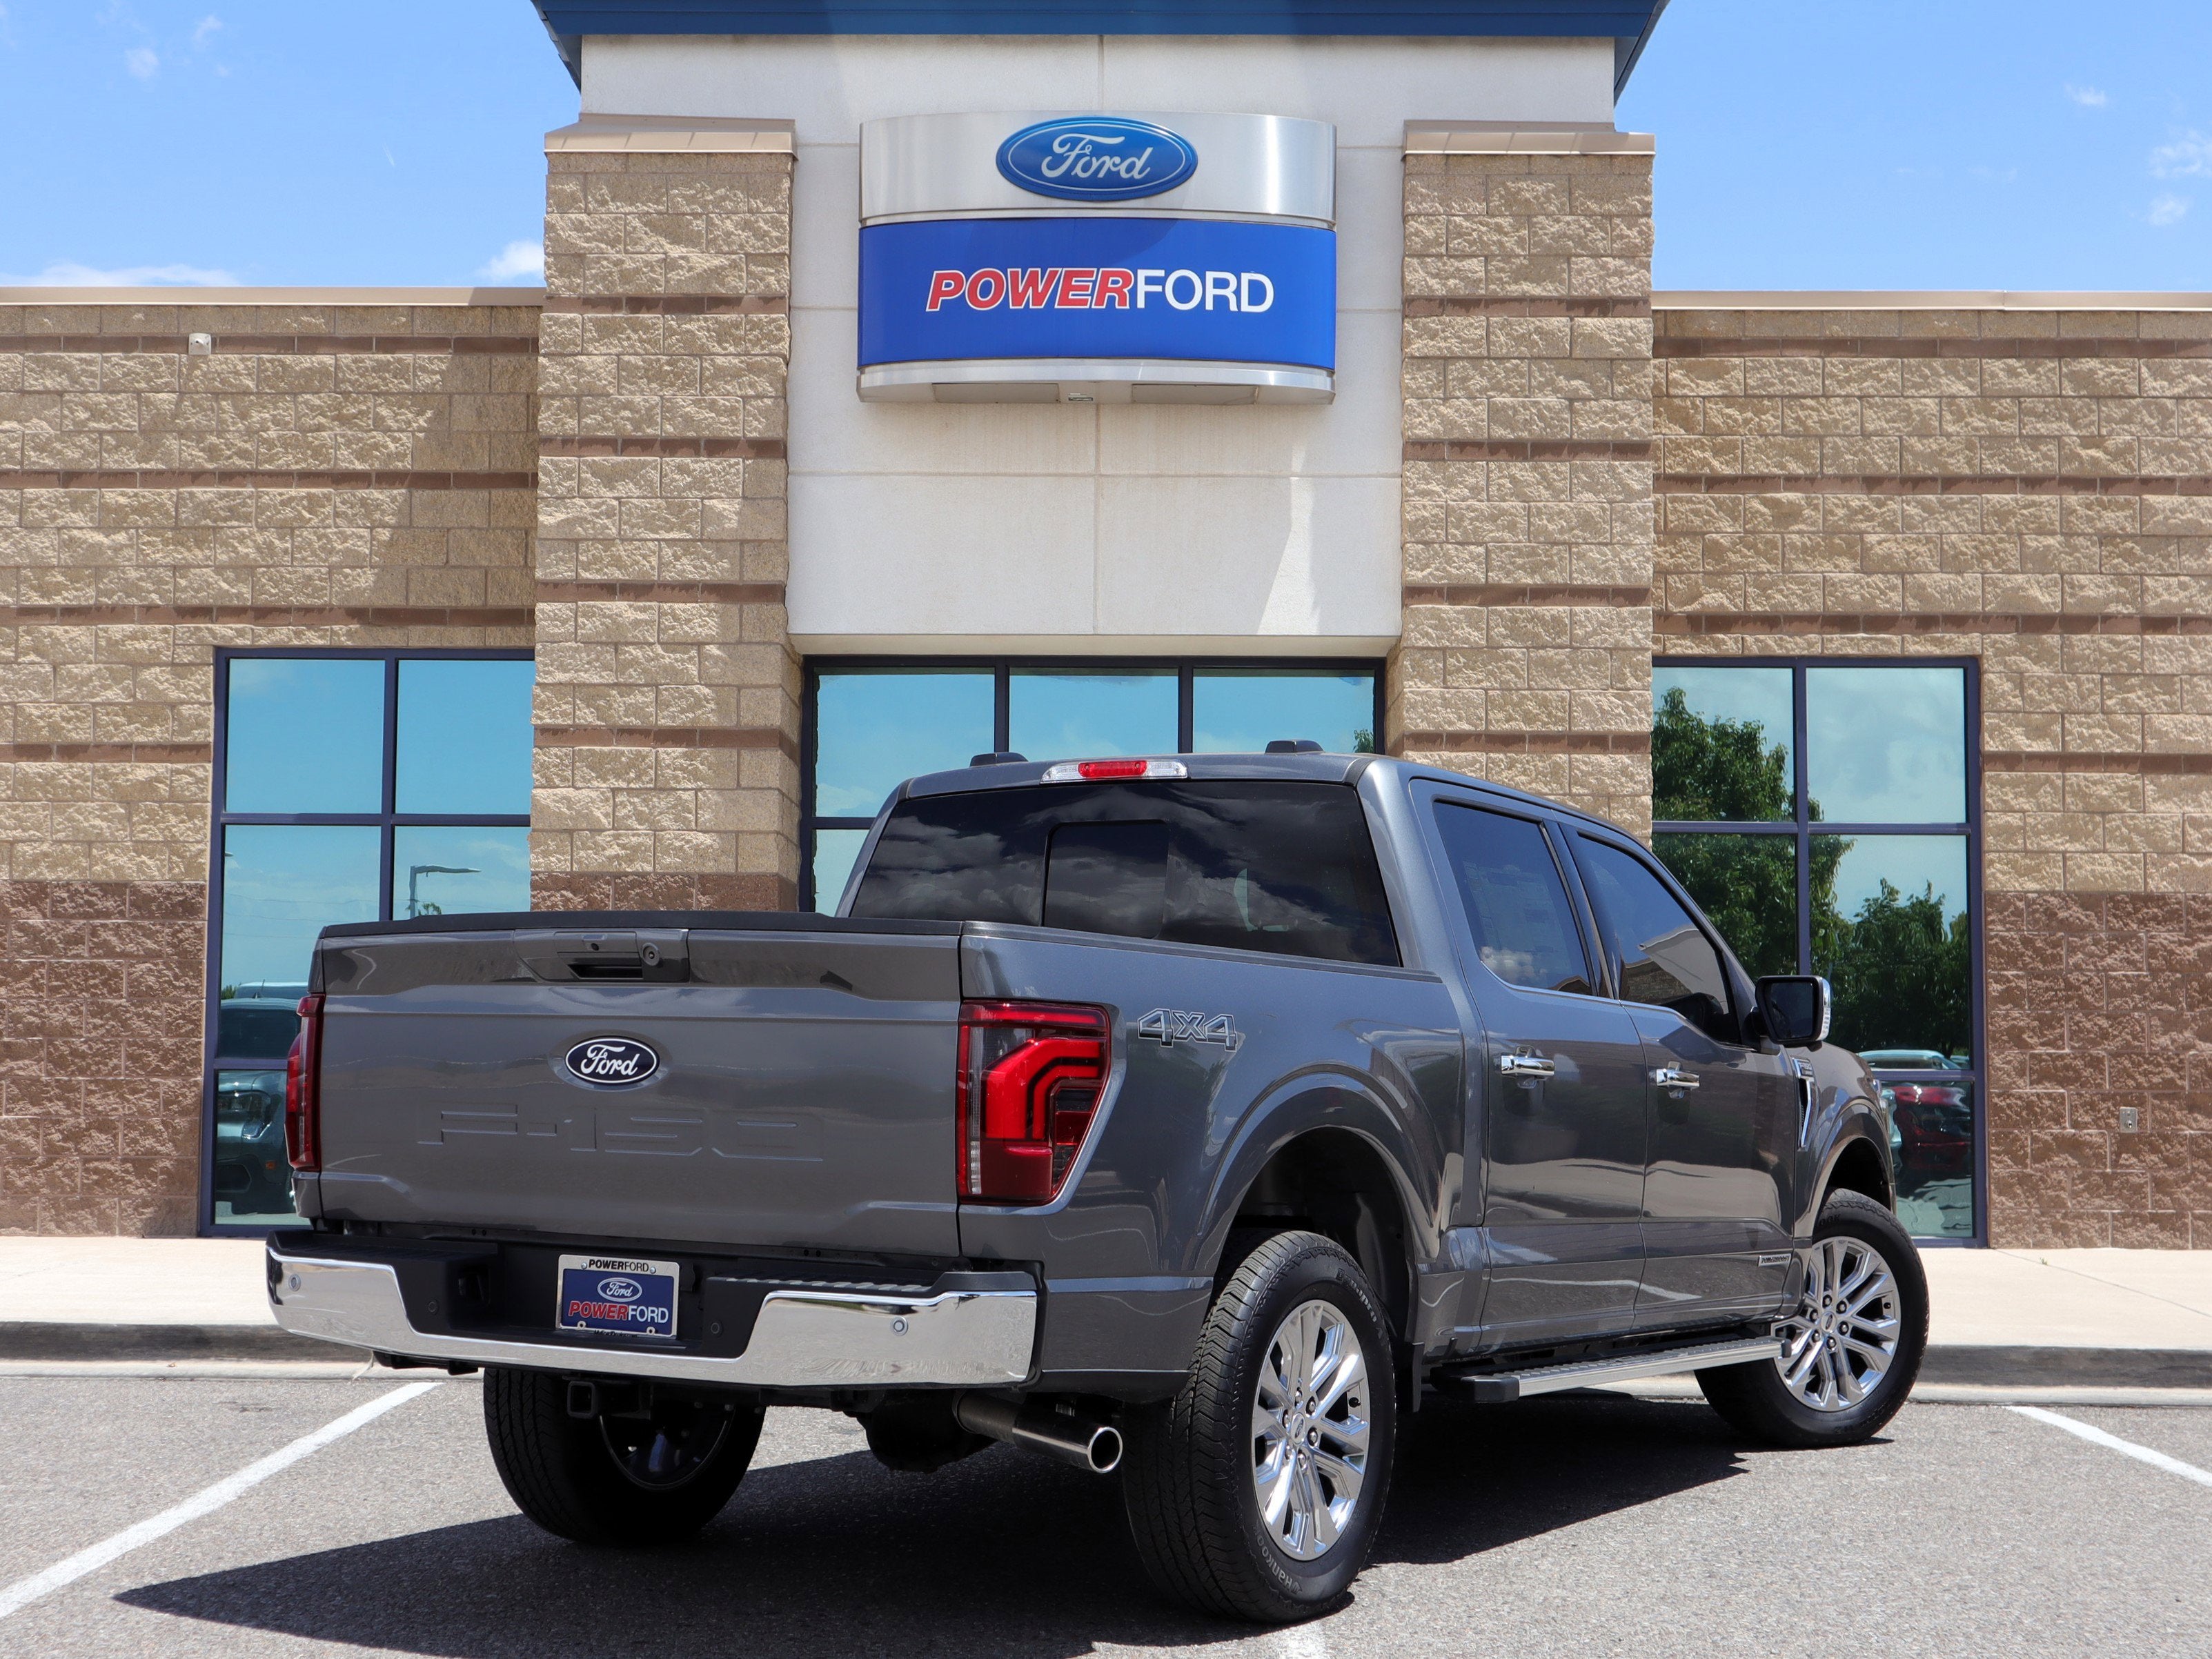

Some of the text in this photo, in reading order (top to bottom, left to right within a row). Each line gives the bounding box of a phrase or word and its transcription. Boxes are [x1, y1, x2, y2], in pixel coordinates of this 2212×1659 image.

[1040, 132, 1154, 181] Ford
[925, 267, 1274, 313] POWERFORD
[580, 1044, 640, 1077] Ford
[416, 1102, 824, 1162] F-150
[589, 1259, 649, 1272] POWERFORD
[606, 1281, 633, 1298] Ford
[568, 1300, 669, 1324] POWERFORD
